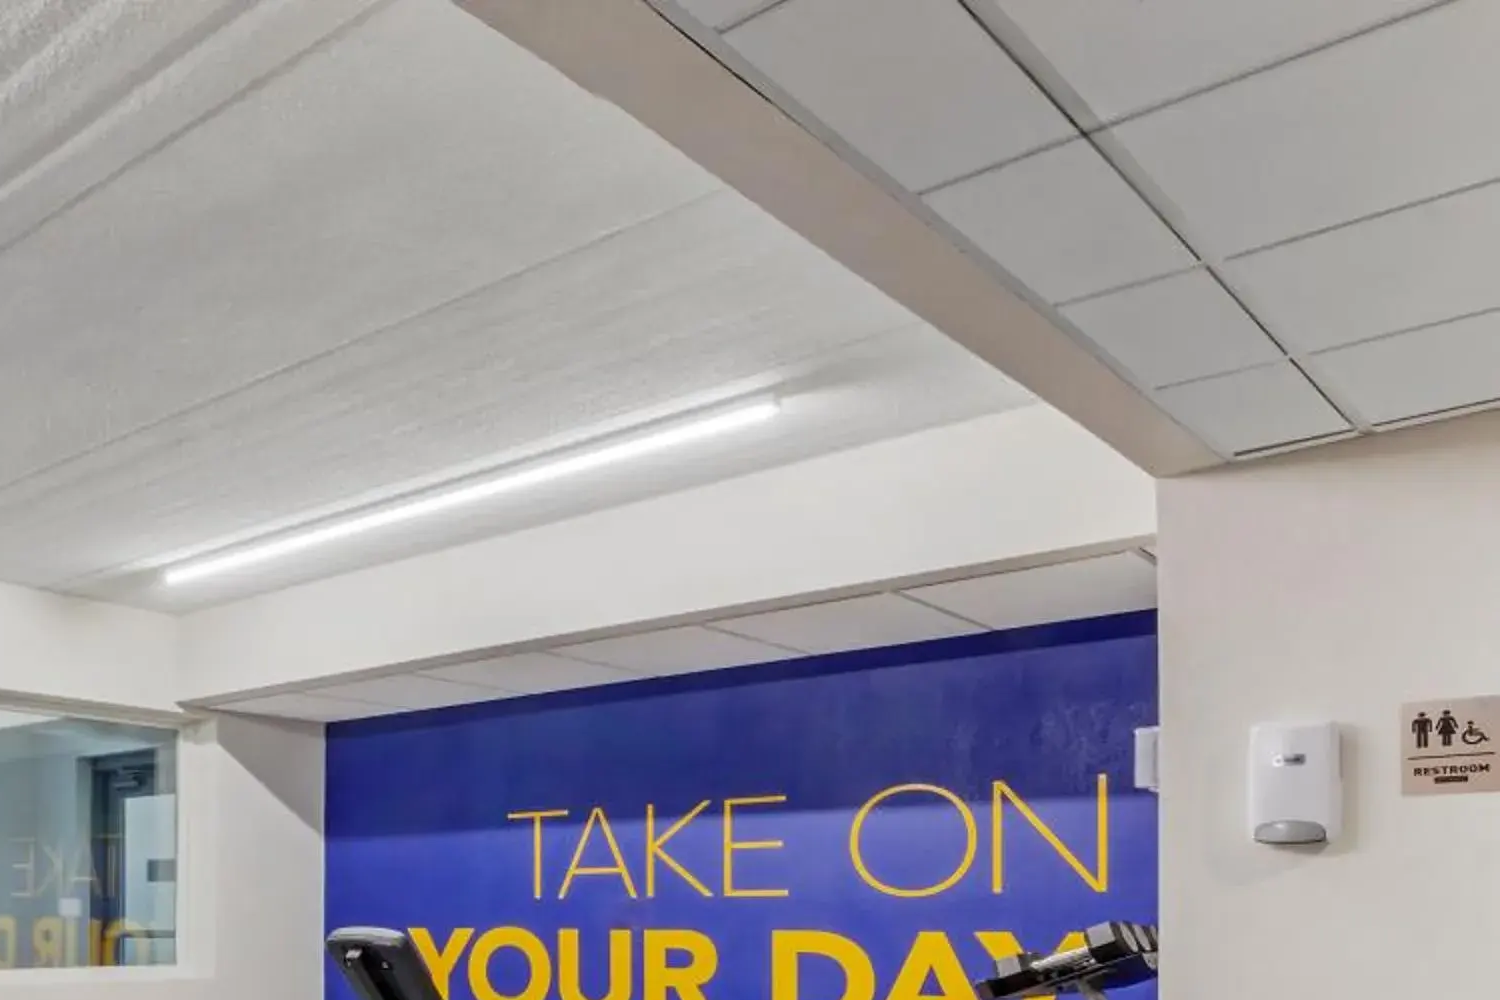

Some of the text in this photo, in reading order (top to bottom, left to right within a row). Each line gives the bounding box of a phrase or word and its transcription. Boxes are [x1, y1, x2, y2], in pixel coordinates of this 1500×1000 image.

[1413, 763, 1491, 776] RESTROOM
[507, 773, 1109, 900] TAKE ON
